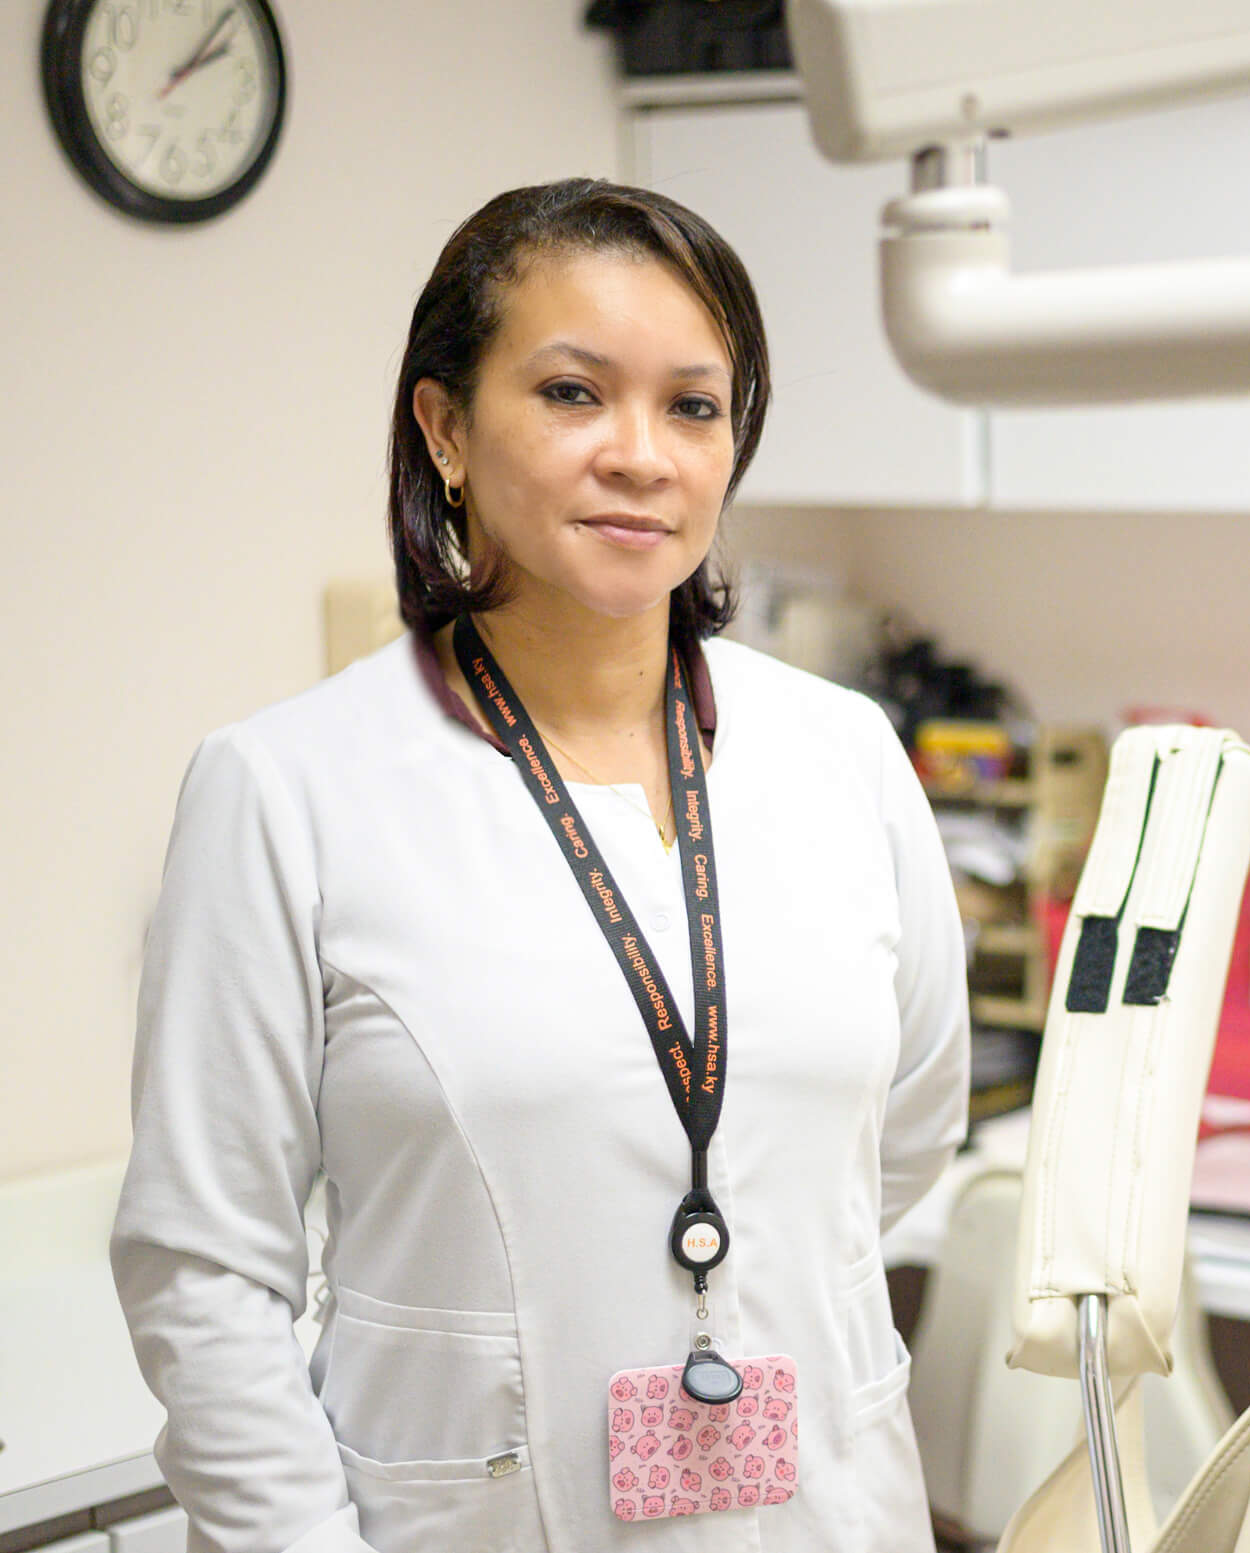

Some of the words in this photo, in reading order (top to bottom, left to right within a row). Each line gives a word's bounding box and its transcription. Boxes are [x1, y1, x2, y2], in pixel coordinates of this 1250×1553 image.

[101, 4, 138, 51] 10
[90, 49, 115, 90] 9
[105, 92, 128, 140] 8
[472, 657, 517, 728] www.hsa.ky
[519, 733, 561, 805] Excellence.
[560, 812, 589, 859] Caring.
[686, 789, 703, 842] Integrity.
[590, 867, 622, 924] Integrity.
[694, 853, 709, 901] Caring.
[701, 913, 718, 993] Excellence.
[622, 933, 673, 1031] Responsibility.
[670, 1041, 692, 1103] spect.
[701, 1004, 721, 1095] www.hsa.ky
